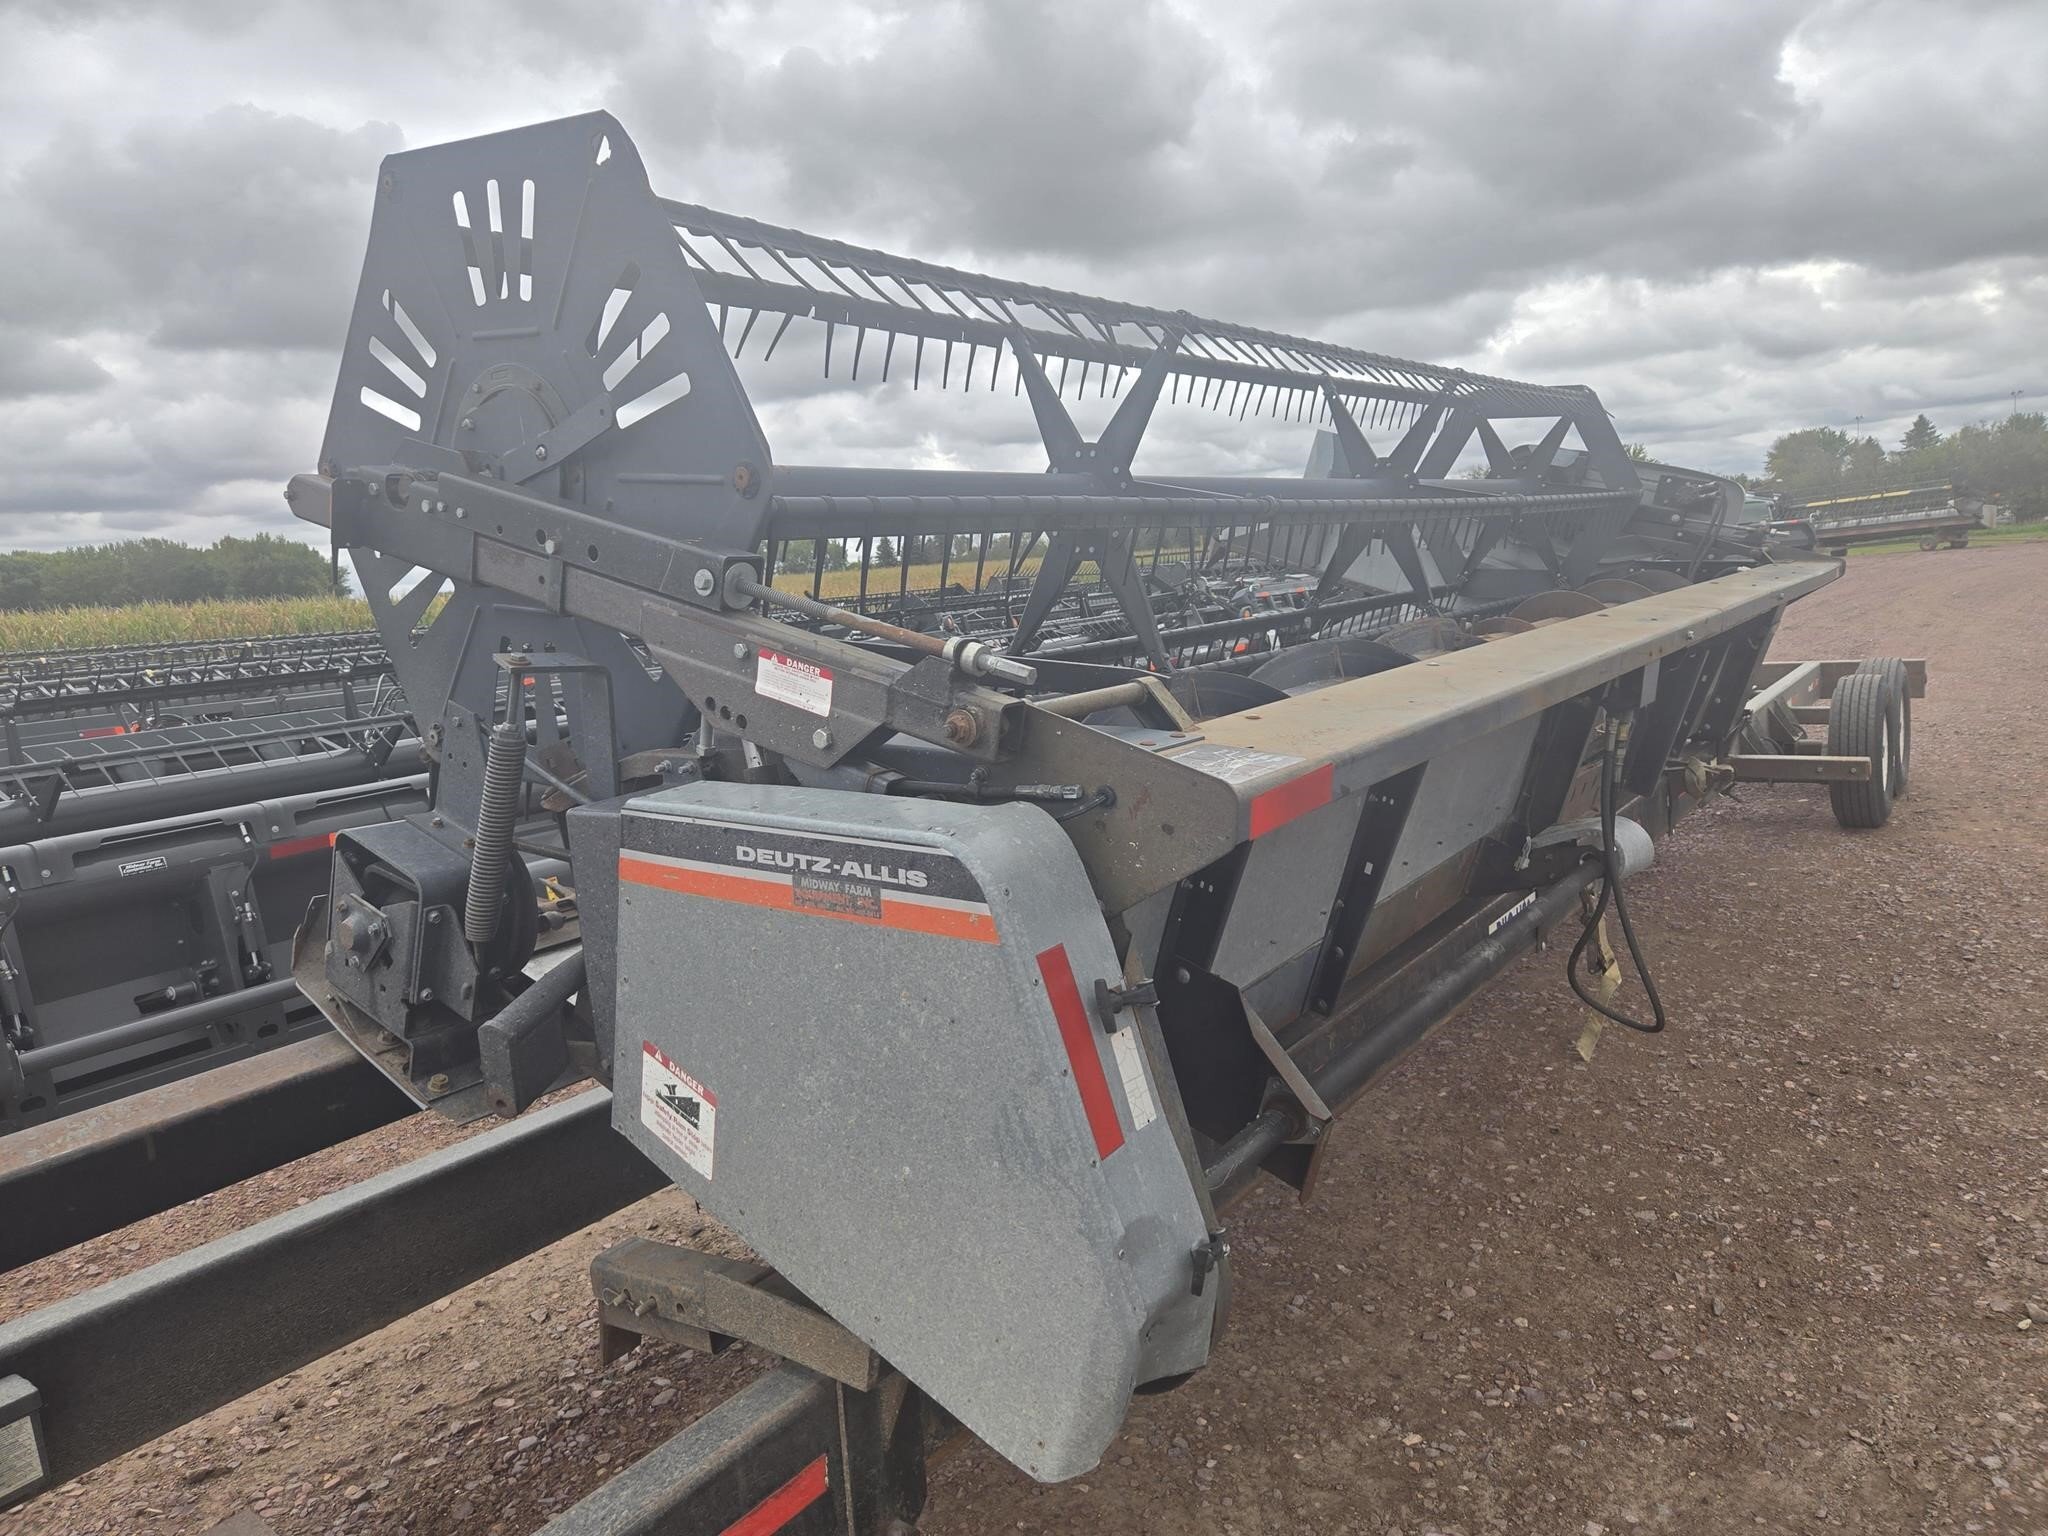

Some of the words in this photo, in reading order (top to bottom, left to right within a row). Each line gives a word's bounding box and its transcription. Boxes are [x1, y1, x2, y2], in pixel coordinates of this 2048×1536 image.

[786, 657, 821, 677] DANGER
[736, 845, 928, 887] DEUTZ-ALLIS
[800, 877, 840, 892] MIDWAY
[844, 884, 873, 897] FARM
[669, 1060, 704, 1096] DANGER
